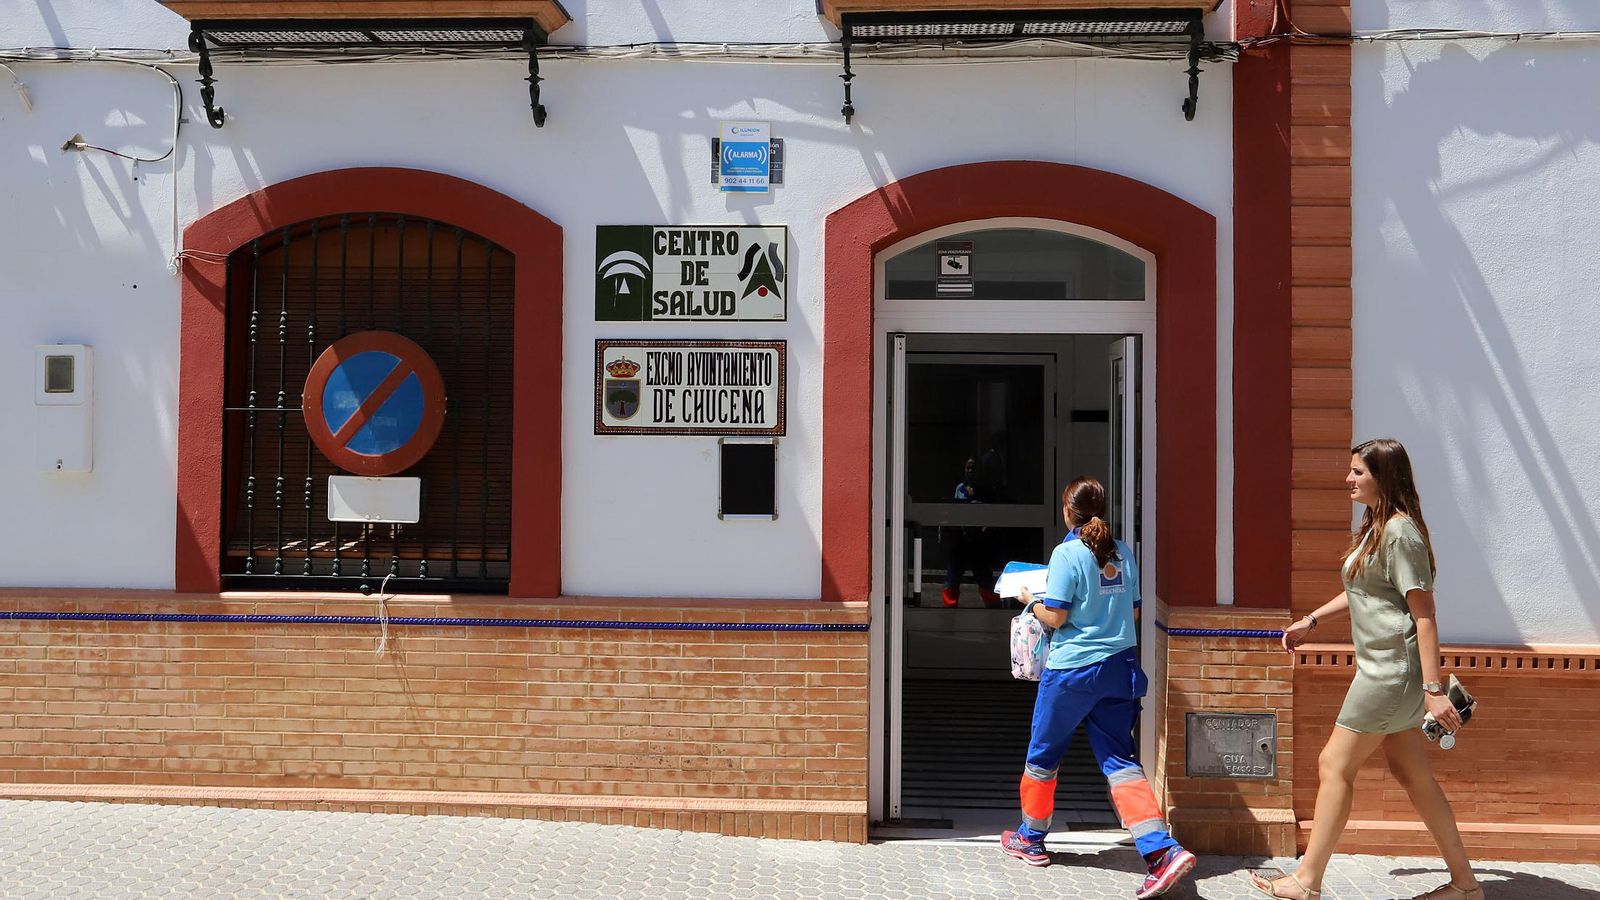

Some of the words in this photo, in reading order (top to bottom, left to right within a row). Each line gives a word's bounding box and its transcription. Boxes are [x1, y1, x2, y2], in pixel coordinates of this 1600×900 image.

[654, 230, 739, 256] CENTRO
[680, 260, 709, 286] DE
[653, 290, 736, 316] SALUD
[646, 351, 683, 386] EXCMO
[687, 351, 772, 387] AYUNTAMIENTO
[653, 388, 676, 423] DE
[682, 389, 765, 424] CHUCENA
